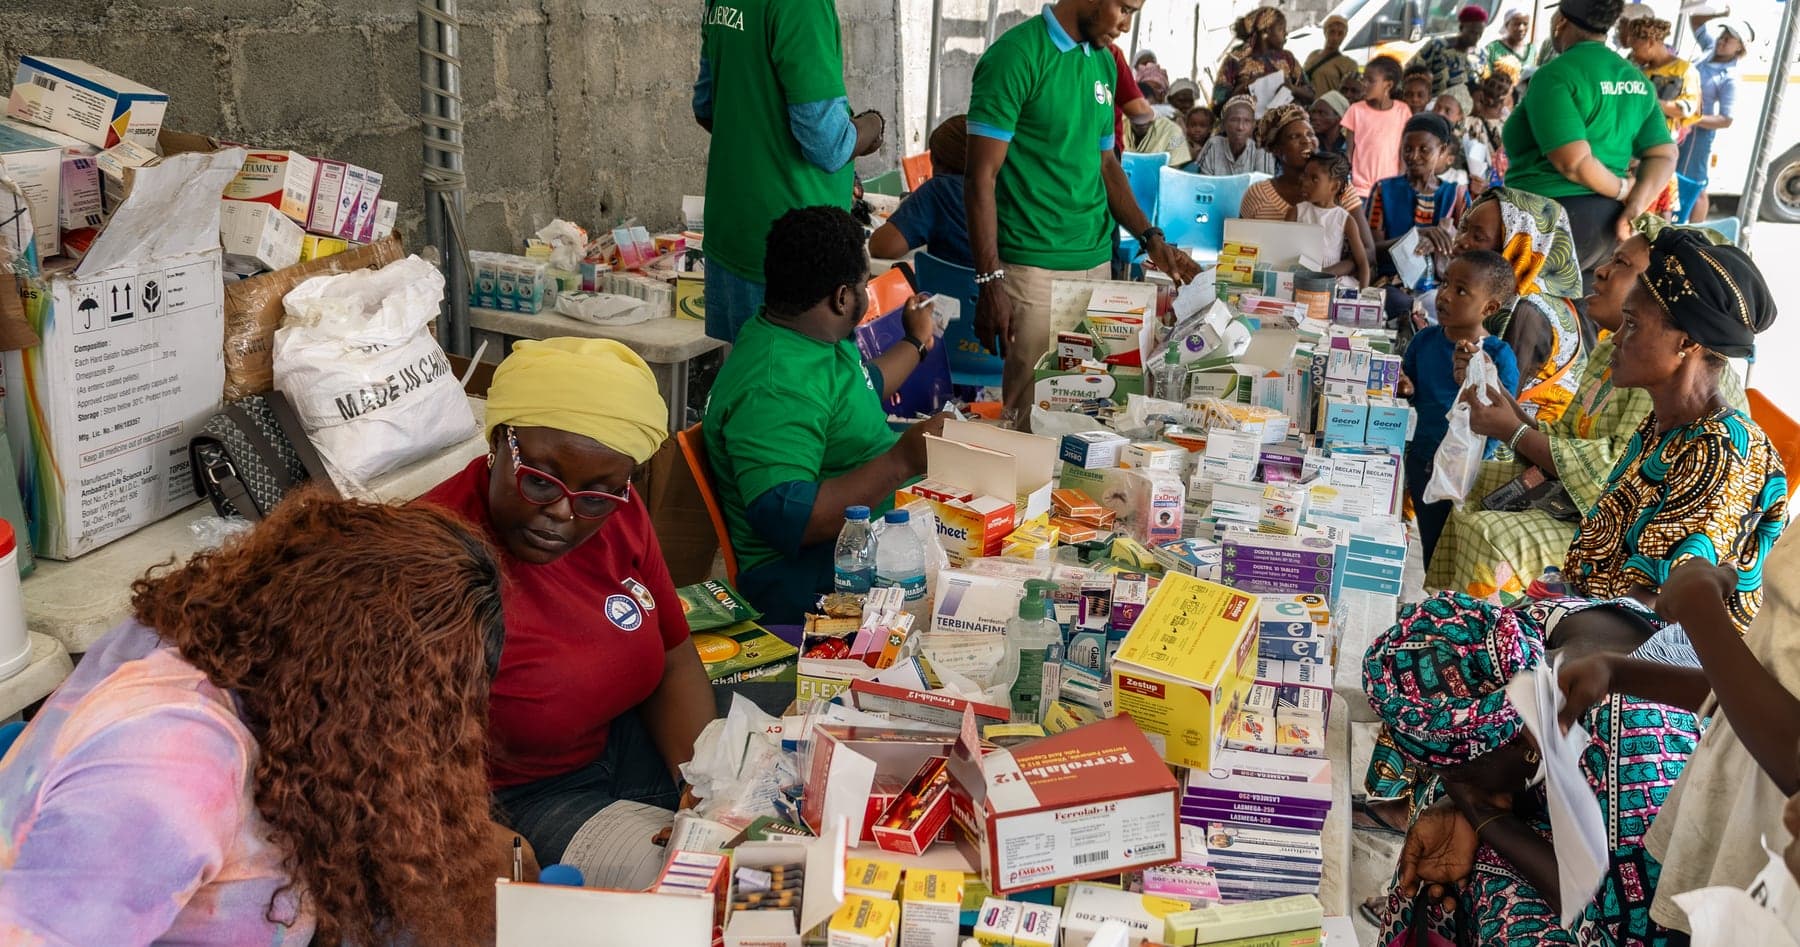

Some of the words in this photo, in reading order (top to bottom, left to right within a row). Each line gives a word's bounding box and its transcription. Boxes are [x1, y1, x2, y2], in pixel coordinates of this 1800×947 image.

[241, 163, 272, 173] ITAMIN
[335, 375, 400, 420] MADE
[399, 364, 421, 394] IN
[419, 348, 450, 384] CHIN
[78, 410, 100, 422] Storage
[1332, 416, 1360, 425] Gecrol
[1373, 420, 1402, 428] Gecrol
[1304, 462, 1330, 470] BECLATIN
[1334, 466, 1361, 474] BECLATIN
[1366, 470, 1393, 478] BECLATIN
[704, 580, 739, 610] altoux
[1054, 592, 1080, 600] ExDr
[936, 616, 1007, 636] TERBINAFINE
[1090, 646, 1100, 669] Glanil
[1126, 678, 1158, 692] Zestup
[908, 691, 956, 706] Ferrolab-12
[1238, 792, 1280, 803] LASMEGA-250
[1054, 804, 1116, 821] Ferrolab-12
[1234, 803, 1275, 814] LASMEGA-250
[1230, 814, 1272, 824] LASMEGA-250
[1018, 864, 1054, 876] EMBASSY
